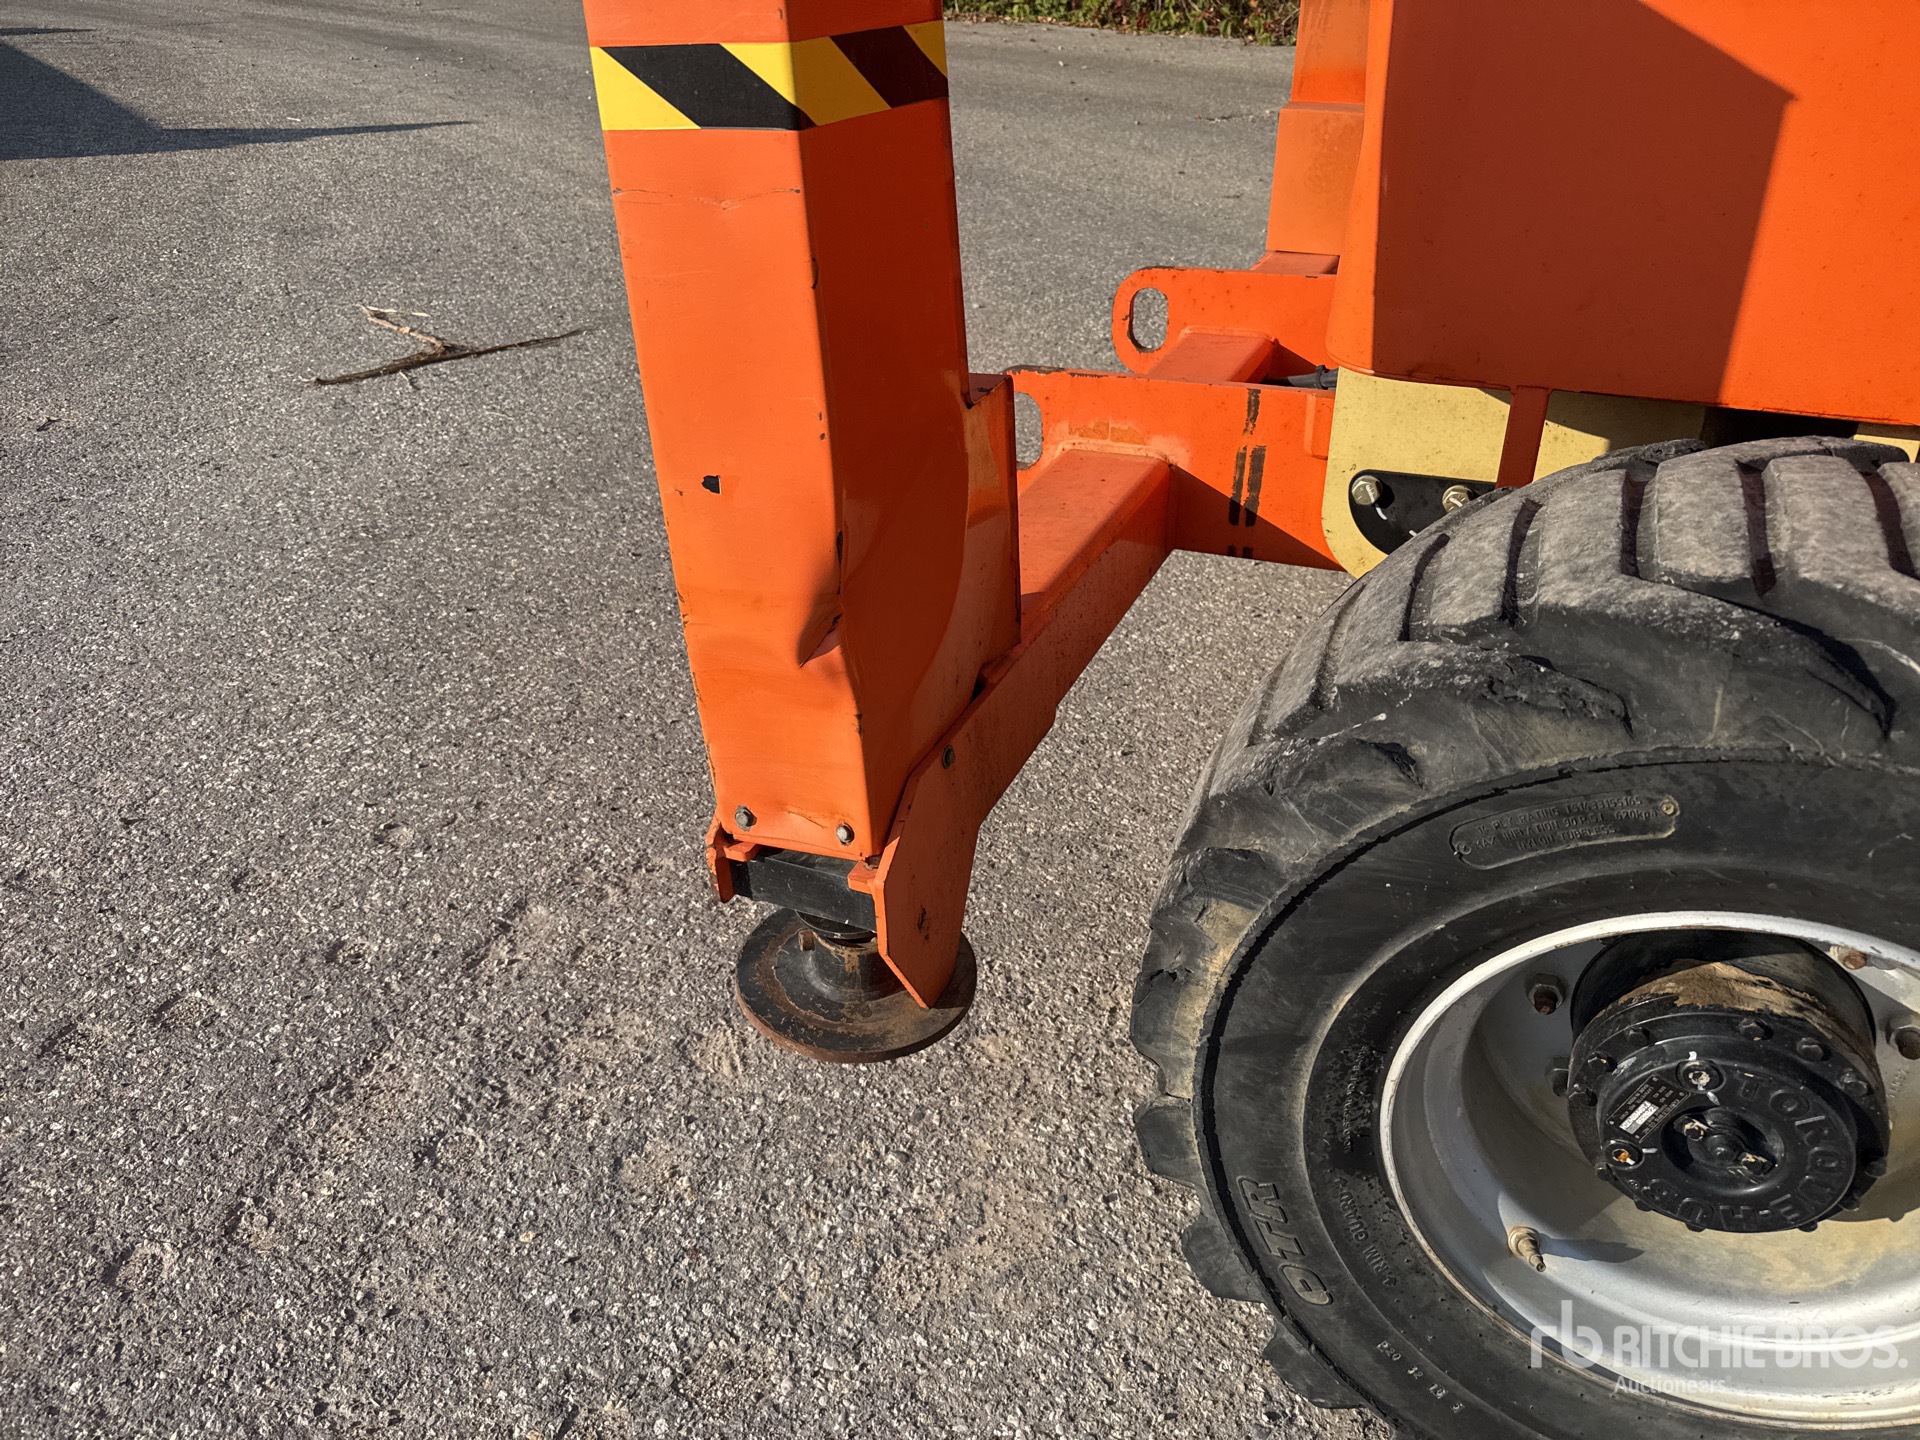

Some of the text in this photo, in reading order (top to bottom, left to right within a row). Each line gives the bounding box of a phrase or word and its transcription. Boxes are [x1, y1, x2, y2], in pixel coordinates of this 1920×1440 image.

[1492, 817, 1513, 831] PLY
[1518, 805, 1560, 825] RATING
[1502, 820, 1560, 841] INFLATION
[1563, 815, 1578, 828] 90
[1615, 808, 1659, 821] 620kpa
[1560, 824, 1616, 841] TUBELESS
[1236, 1175, 1334, 1305] OTR
[1339, 1190, 1390, 1274] RIM GUARD
